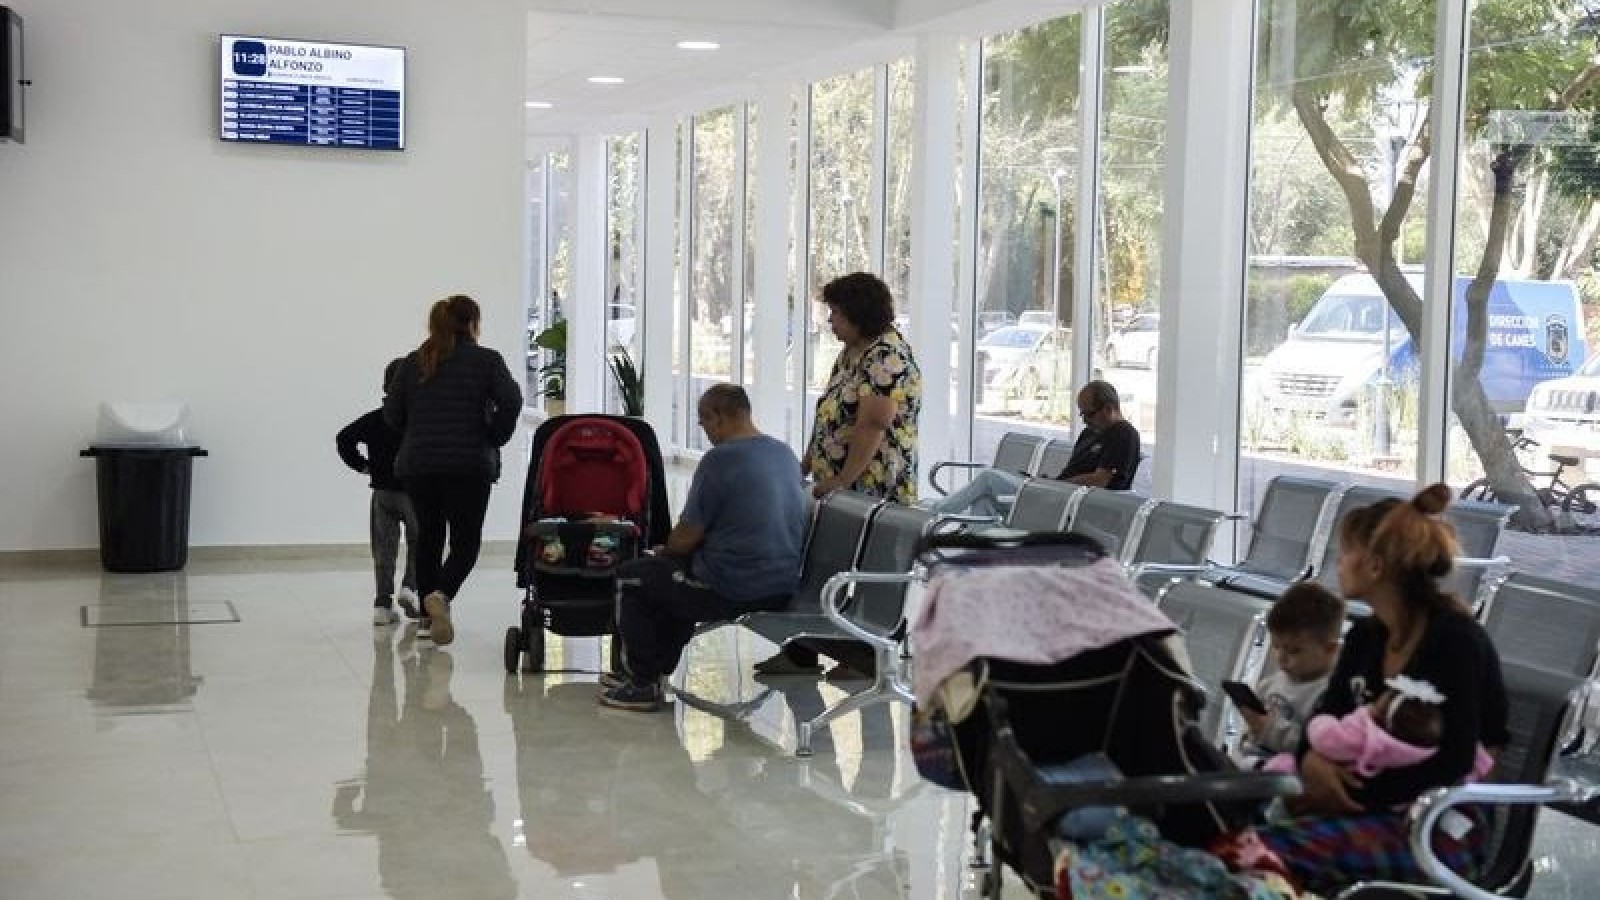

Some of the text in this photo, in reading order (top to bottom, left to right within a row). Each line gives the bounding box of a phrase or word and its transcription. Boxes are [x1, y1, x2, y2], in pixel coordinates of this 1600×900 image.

[269, 45, 352, 60] PABLO ALBINO
[269, 59, 323, 72] ALFONZO
[1489, 332, 1503, 346] DE
